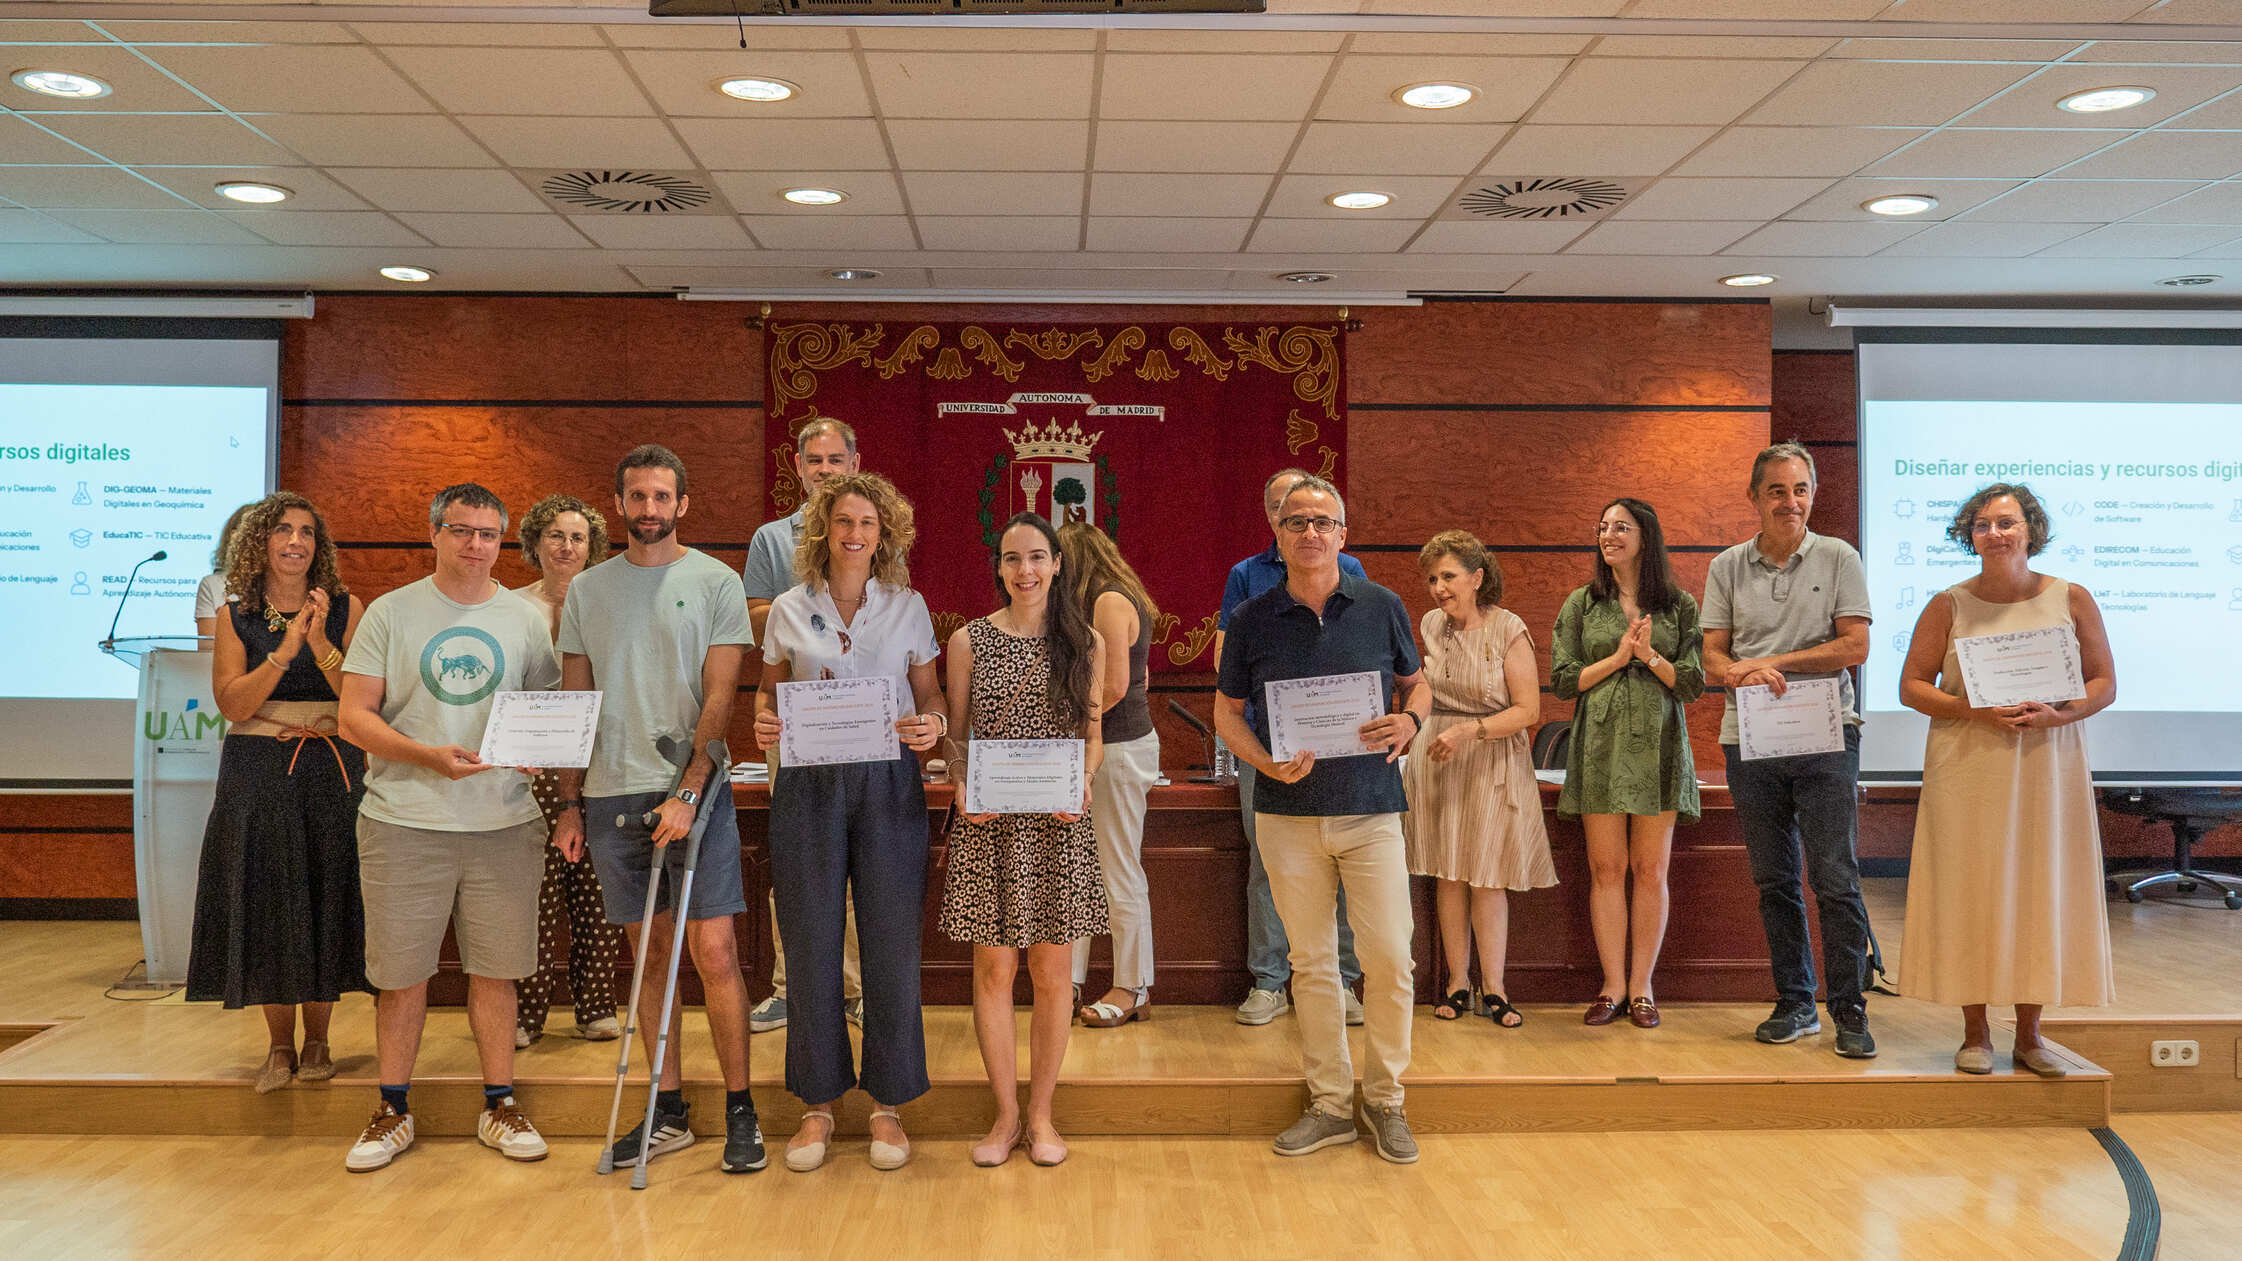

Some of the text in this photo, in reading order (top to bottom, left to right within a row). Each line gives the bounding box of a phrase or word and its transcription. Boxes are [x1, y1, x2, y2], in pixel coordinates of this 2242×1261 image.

[945, 394, 1155, 415] UNIVERSIDAD AUTONOMA DE MADRID
[47, 443, 131, 464] digitales
[1894, 459, 1969, 478] Diseñar
[1974, 460, 2095, 484] experiencias
[2100, 465, 2111, 482] y
[2116, 463, 2199, 478] recursos
[168, 486, 212, 495] Materiales
[103, 531, 144, 539] EducaTIC
[170, 532, 212, 541] Educativa
[145, 712, 226, 741] UAM
